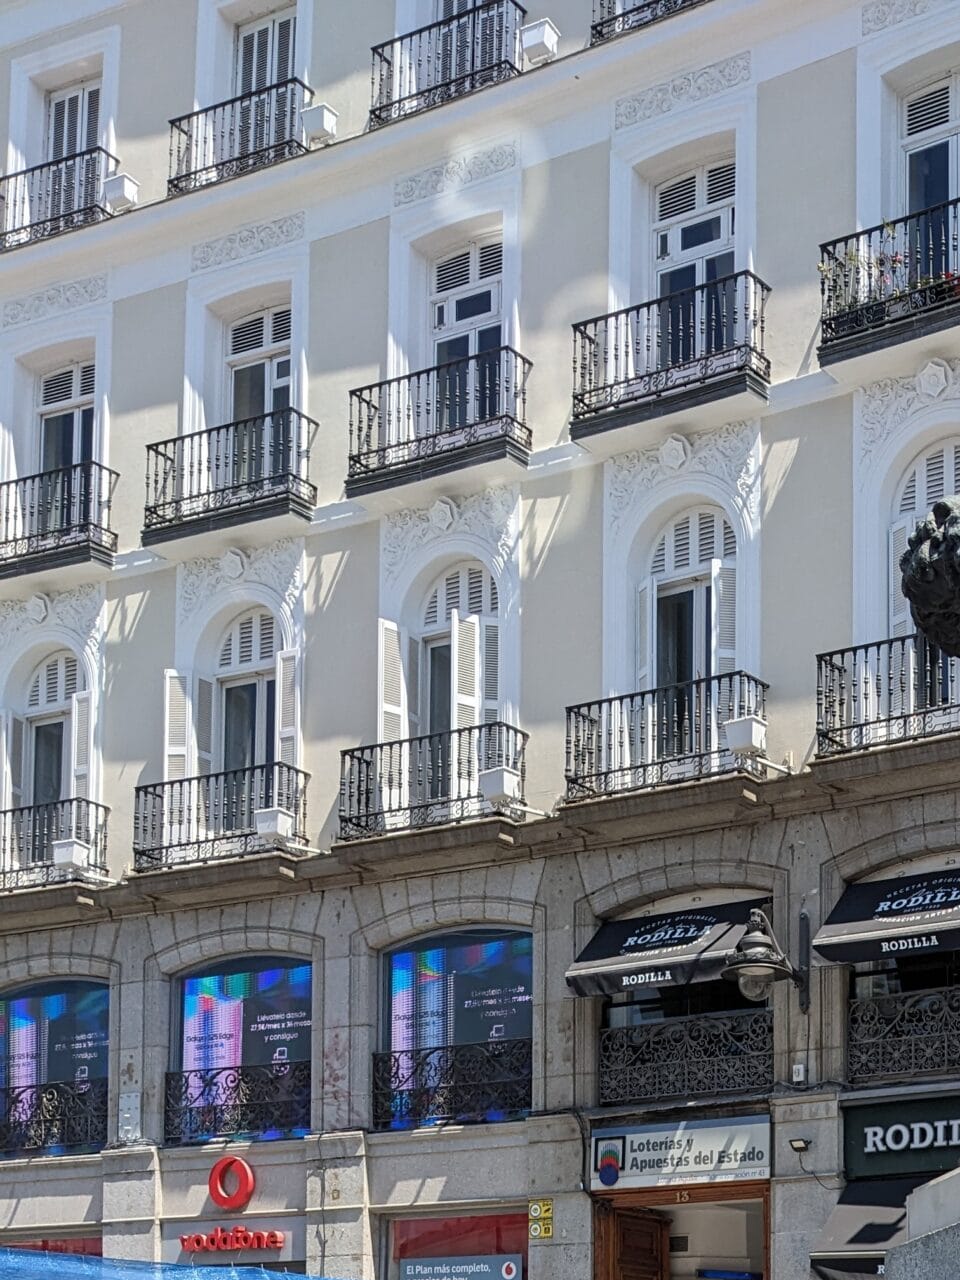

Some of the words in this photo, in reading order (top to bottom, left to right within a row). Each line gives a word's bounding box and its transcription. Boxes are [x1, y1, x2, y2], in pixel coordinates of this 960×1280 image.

[622, 925, 713, 947] RODILLA
[881, 935, 939, 952] RODILLA
[622, 970, 672, 986] RODILLA
[629, 1136, 683, 1153] Loterías
[684, 1137, 694, 1152] y
[629, 1154, 690, 1172] Apuestas
[693, 1150, 714, 1166] del
[717, 1146, 765, 1164] Estado
[675, 1191, 690, 1202] 13
[180, 1226, 285, 1252] vodafone
[406, 1265, 415, 1275] El
[415, 1264, 433, 1275] Plan
[433, 1263, 450, 1274] más
[451, 1263, 491, 1275] completo,
